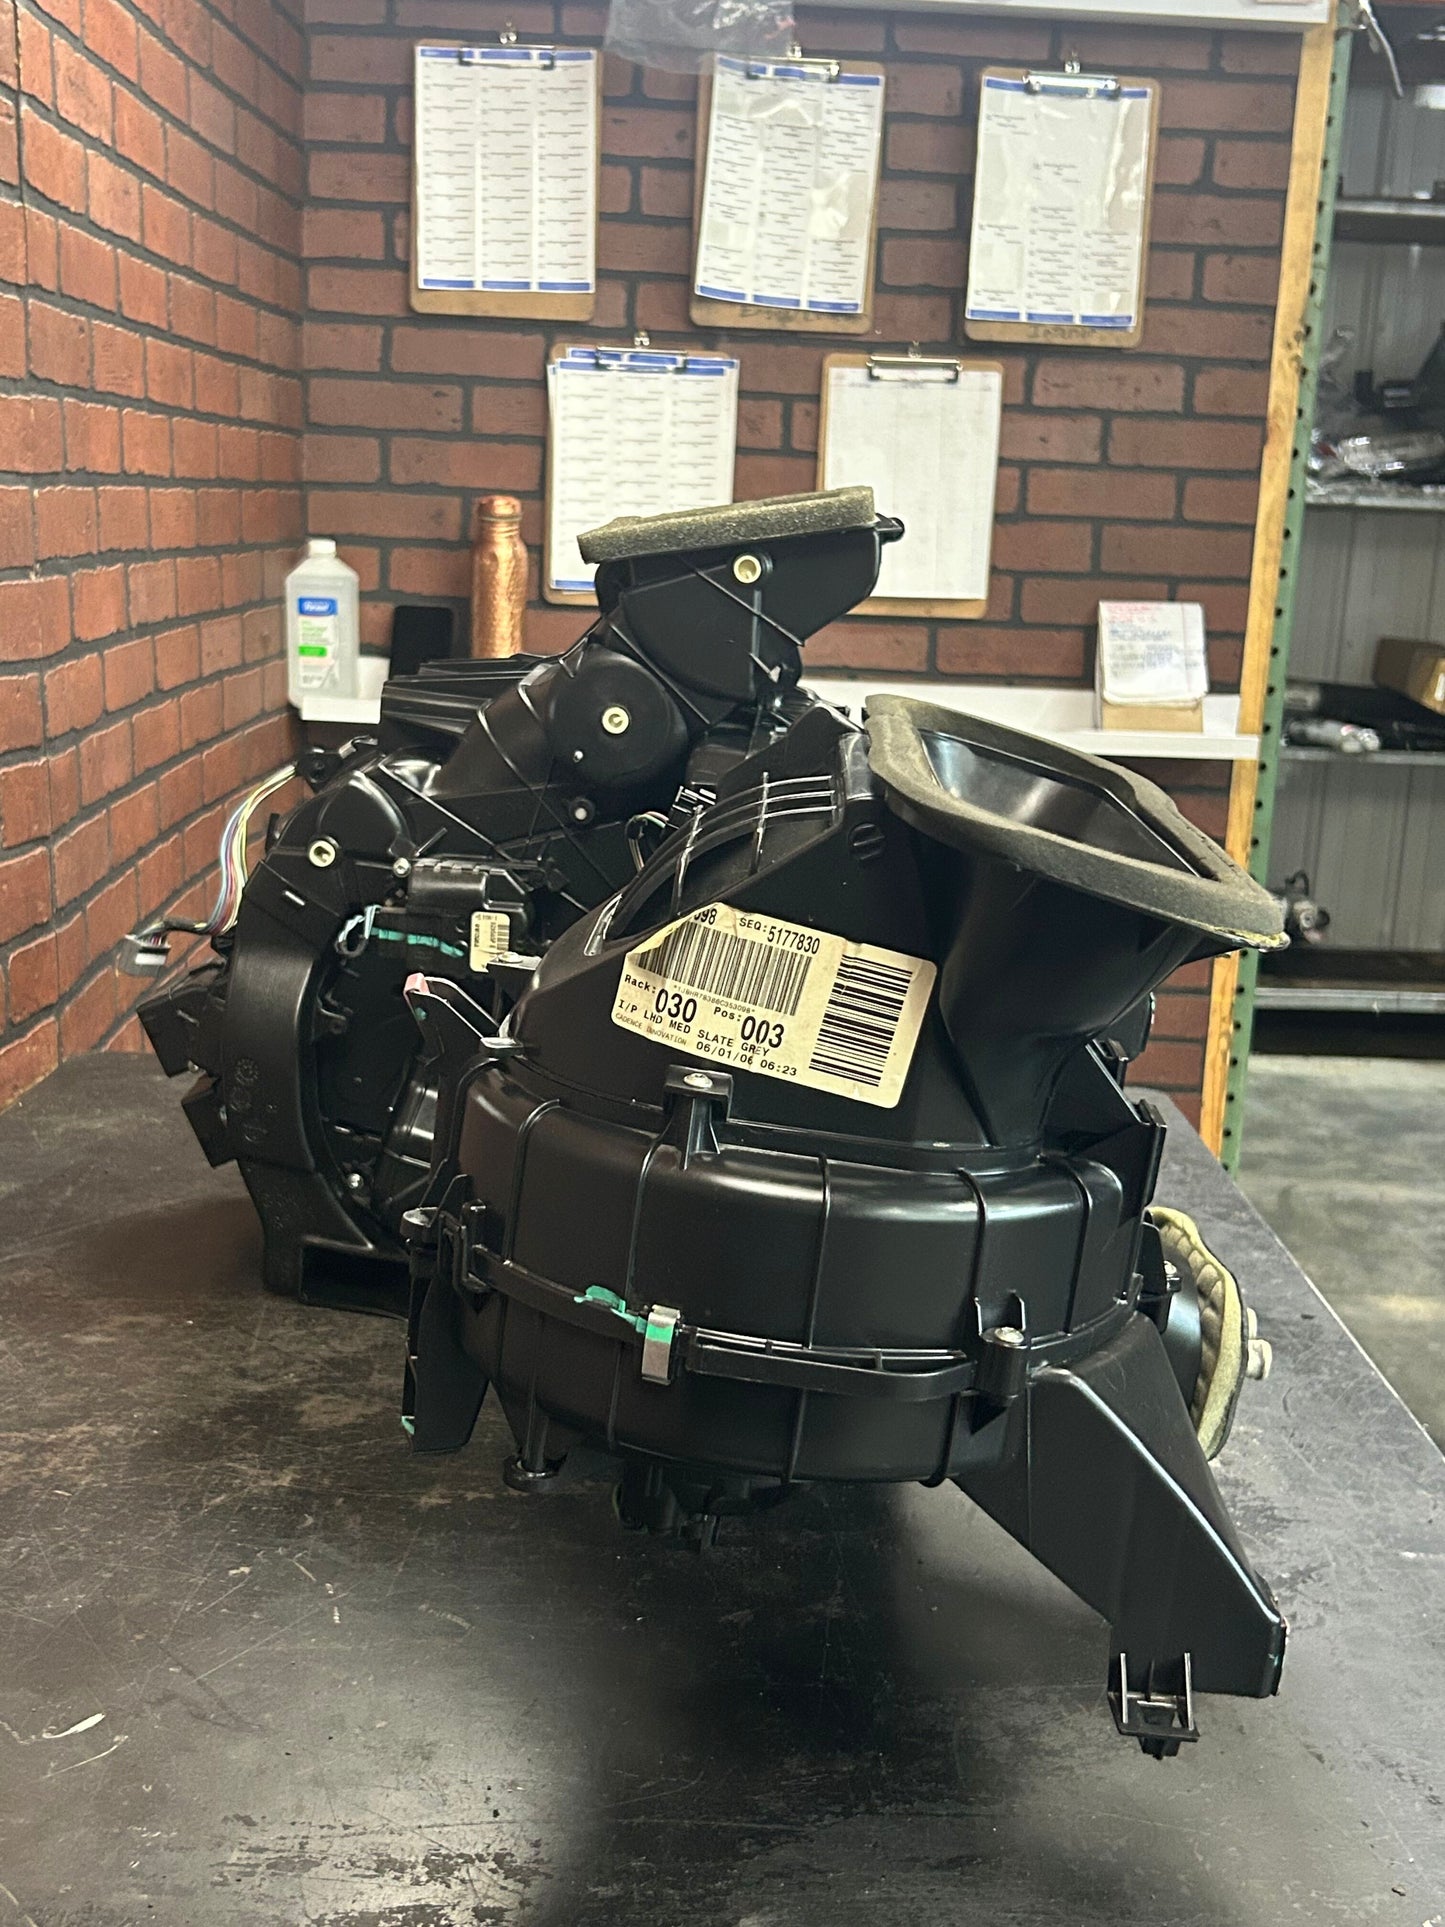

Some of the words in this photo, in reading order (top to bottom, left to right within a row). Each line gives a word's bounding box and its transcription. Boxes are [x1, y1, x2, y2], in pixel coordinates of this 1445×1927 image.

[739, 917, 768, 933] SEQ:
[767, 925, 821, 955] 5177830
[618, 999, 638, 1013] I/P
[643, 1009, 663, 1025] LHD
[668, 1019, 691, 1034] MED
[697, 1029, 735, 1048] SLATE
[740, 1042, 770, 1057] GREY
[624, 974, 657, 994] Rack:
[655, 988, 698, 1023] 030
[713, 1006, 742, 1022] Pos:
[740, 1015, 785, 1049] 003
[696, 1041, 754, 1066] 06/01/06
[760, 1059, 798, 1077] 06:23
